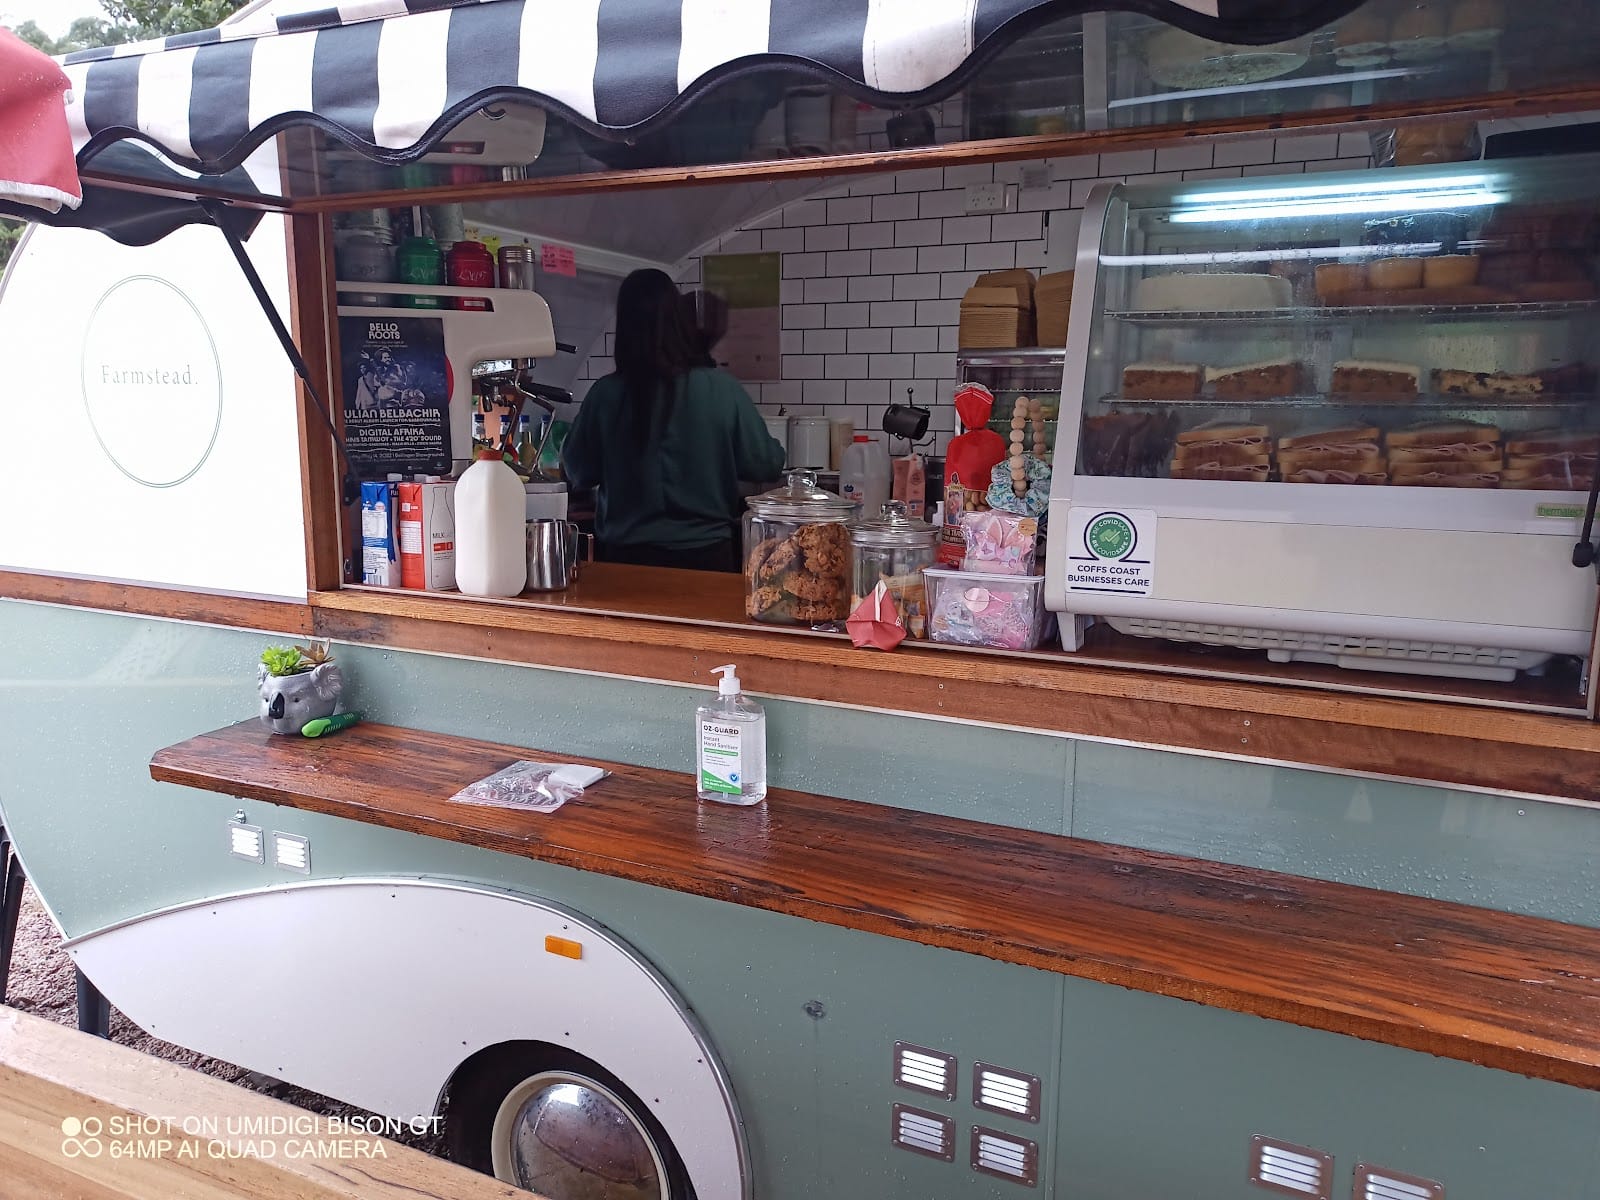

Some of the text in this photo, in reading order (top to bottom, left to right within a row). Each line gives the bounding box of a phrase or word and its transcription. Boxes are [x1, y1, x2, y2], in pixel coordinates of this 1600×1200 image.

[369, 322, 398, 331] BELLO
[368, 331, 401, 340] ROOTS
[101, 364, 198, 385] Farmstead.
[344, 408, 441, 418] ULIAN BELBACHIR
[393, 428, 425, 436] AFRIKA
[1077, 565, 1140, 575] COFFS COAST
[1067, 574, 1150, 587] BUSINESSES CARE
[703, 725, 739, 735] OZ-GUARD
